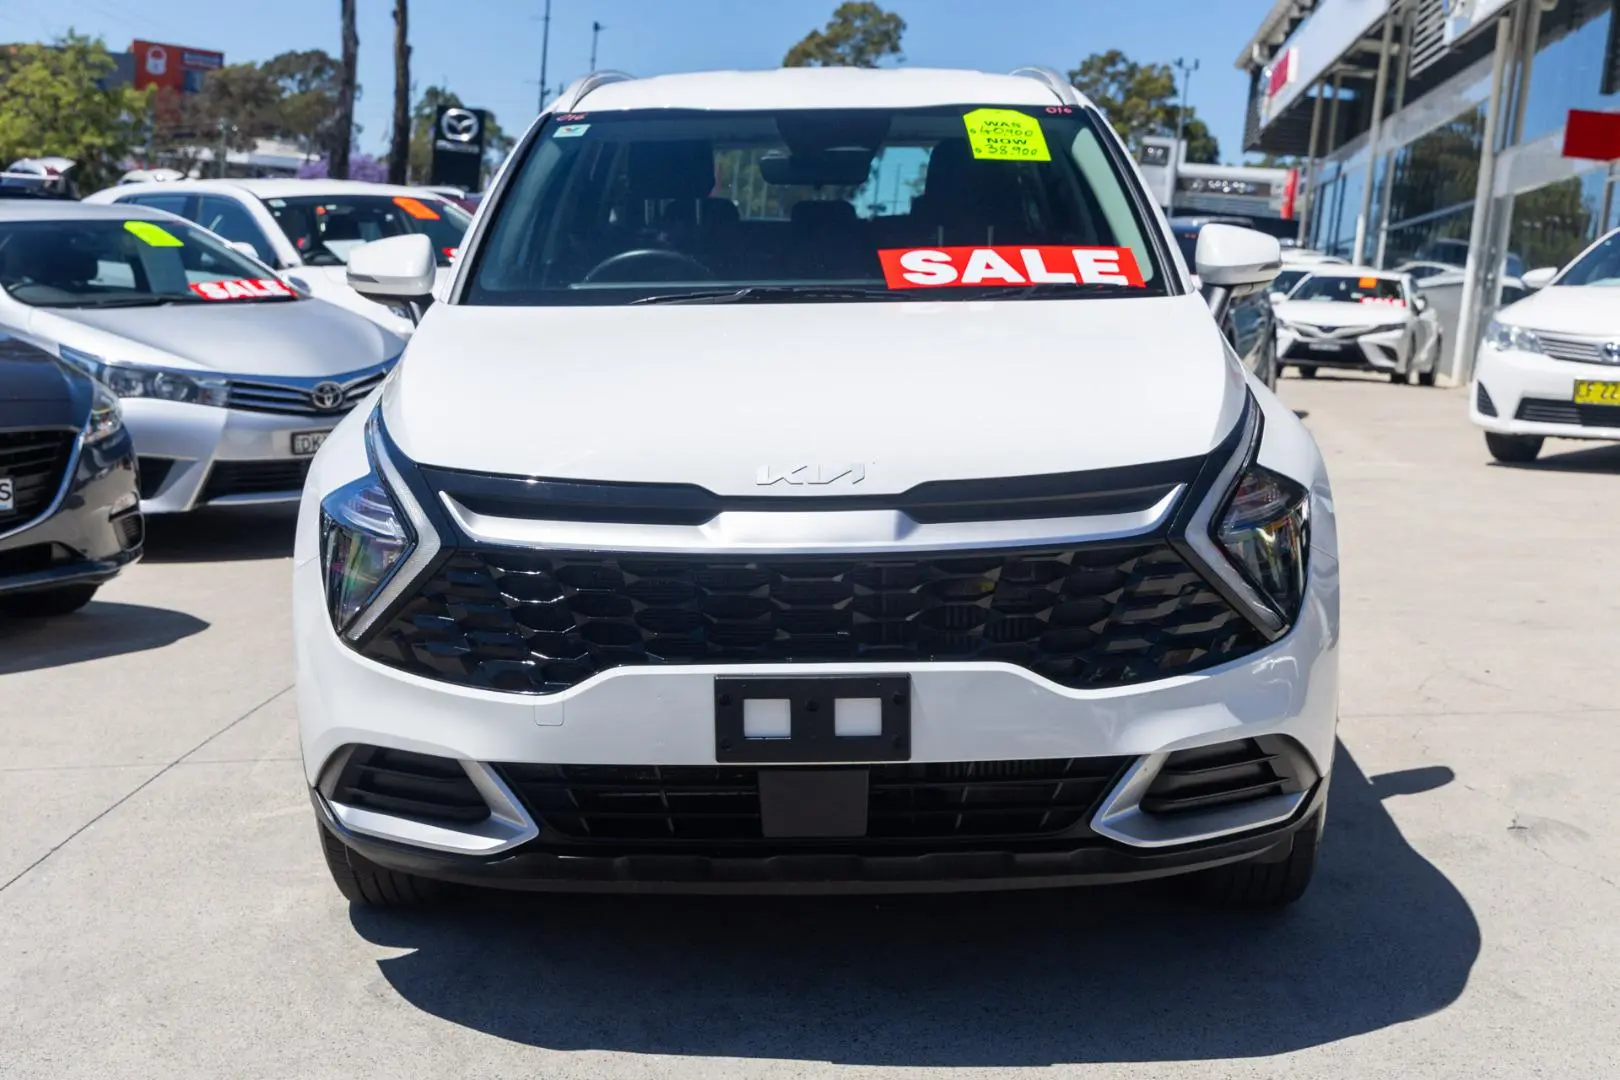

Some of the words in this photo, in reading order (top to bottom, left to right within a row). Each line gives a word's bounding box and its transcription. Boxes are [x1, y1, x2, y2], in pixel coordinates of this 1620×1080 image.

[983, 120, 1022, 128] WAS
[986, 137, 1027, 145] NOW
[899, 248, 1130, 286] SALE
[197, 279, 292, 300] SALE
